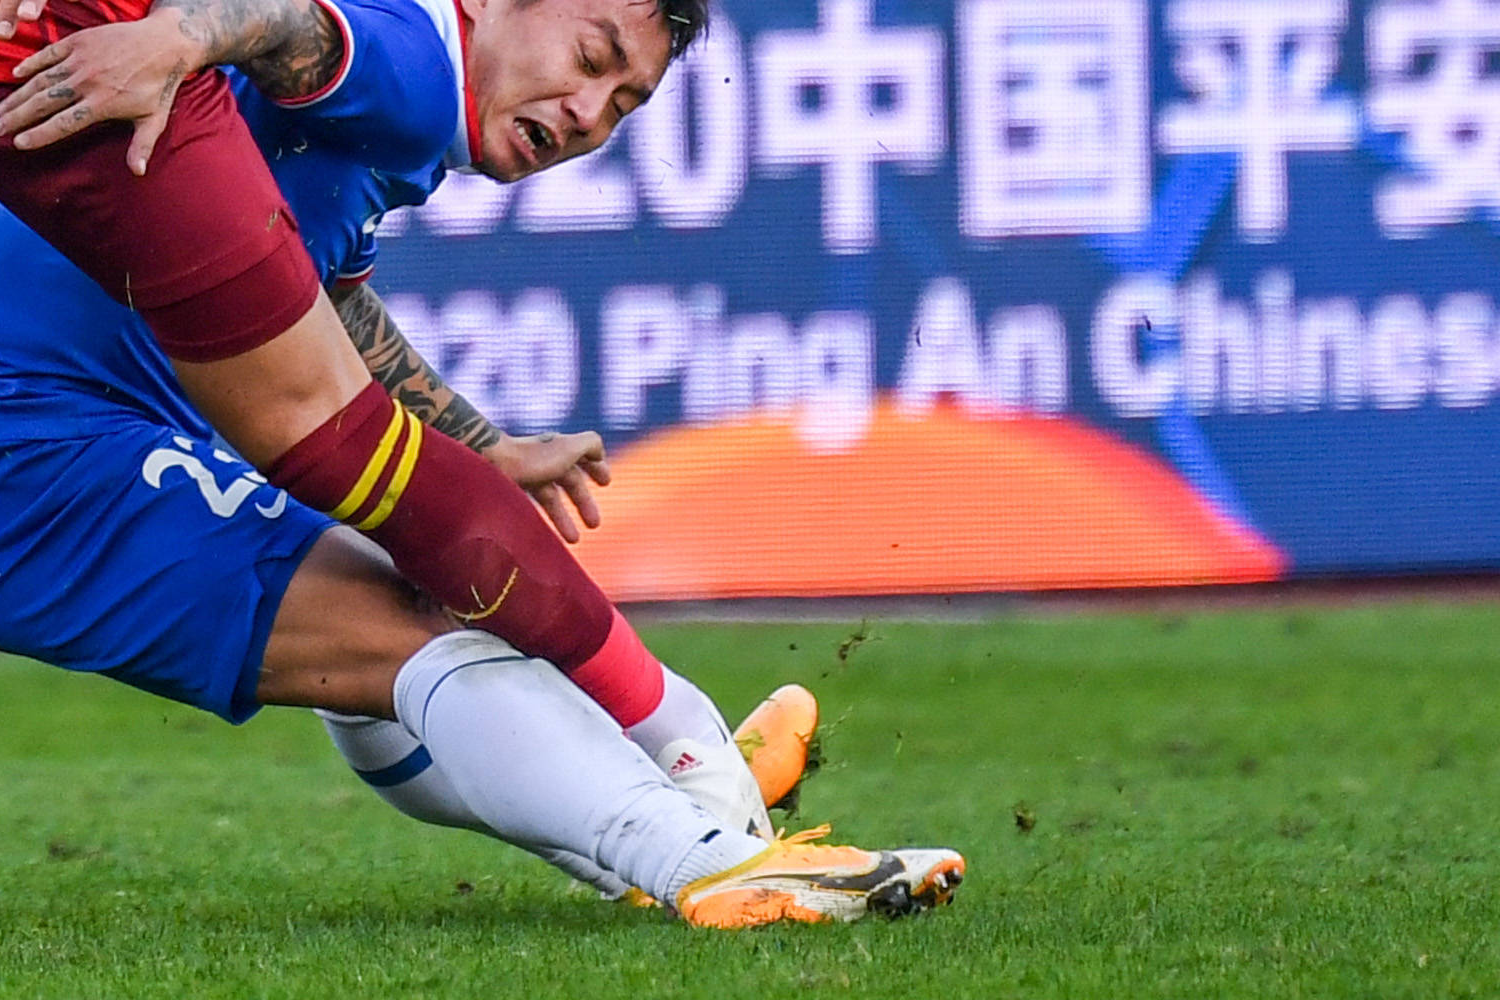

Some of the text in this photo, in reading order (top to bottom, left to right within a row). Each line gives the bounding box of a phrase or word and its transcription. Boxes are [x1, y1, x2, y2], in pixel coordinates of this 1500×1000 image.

[599, 282, 877, 456] Ping
[896, 276, 1069, 422] An
[1090, 264, 1500, 418] Chines
